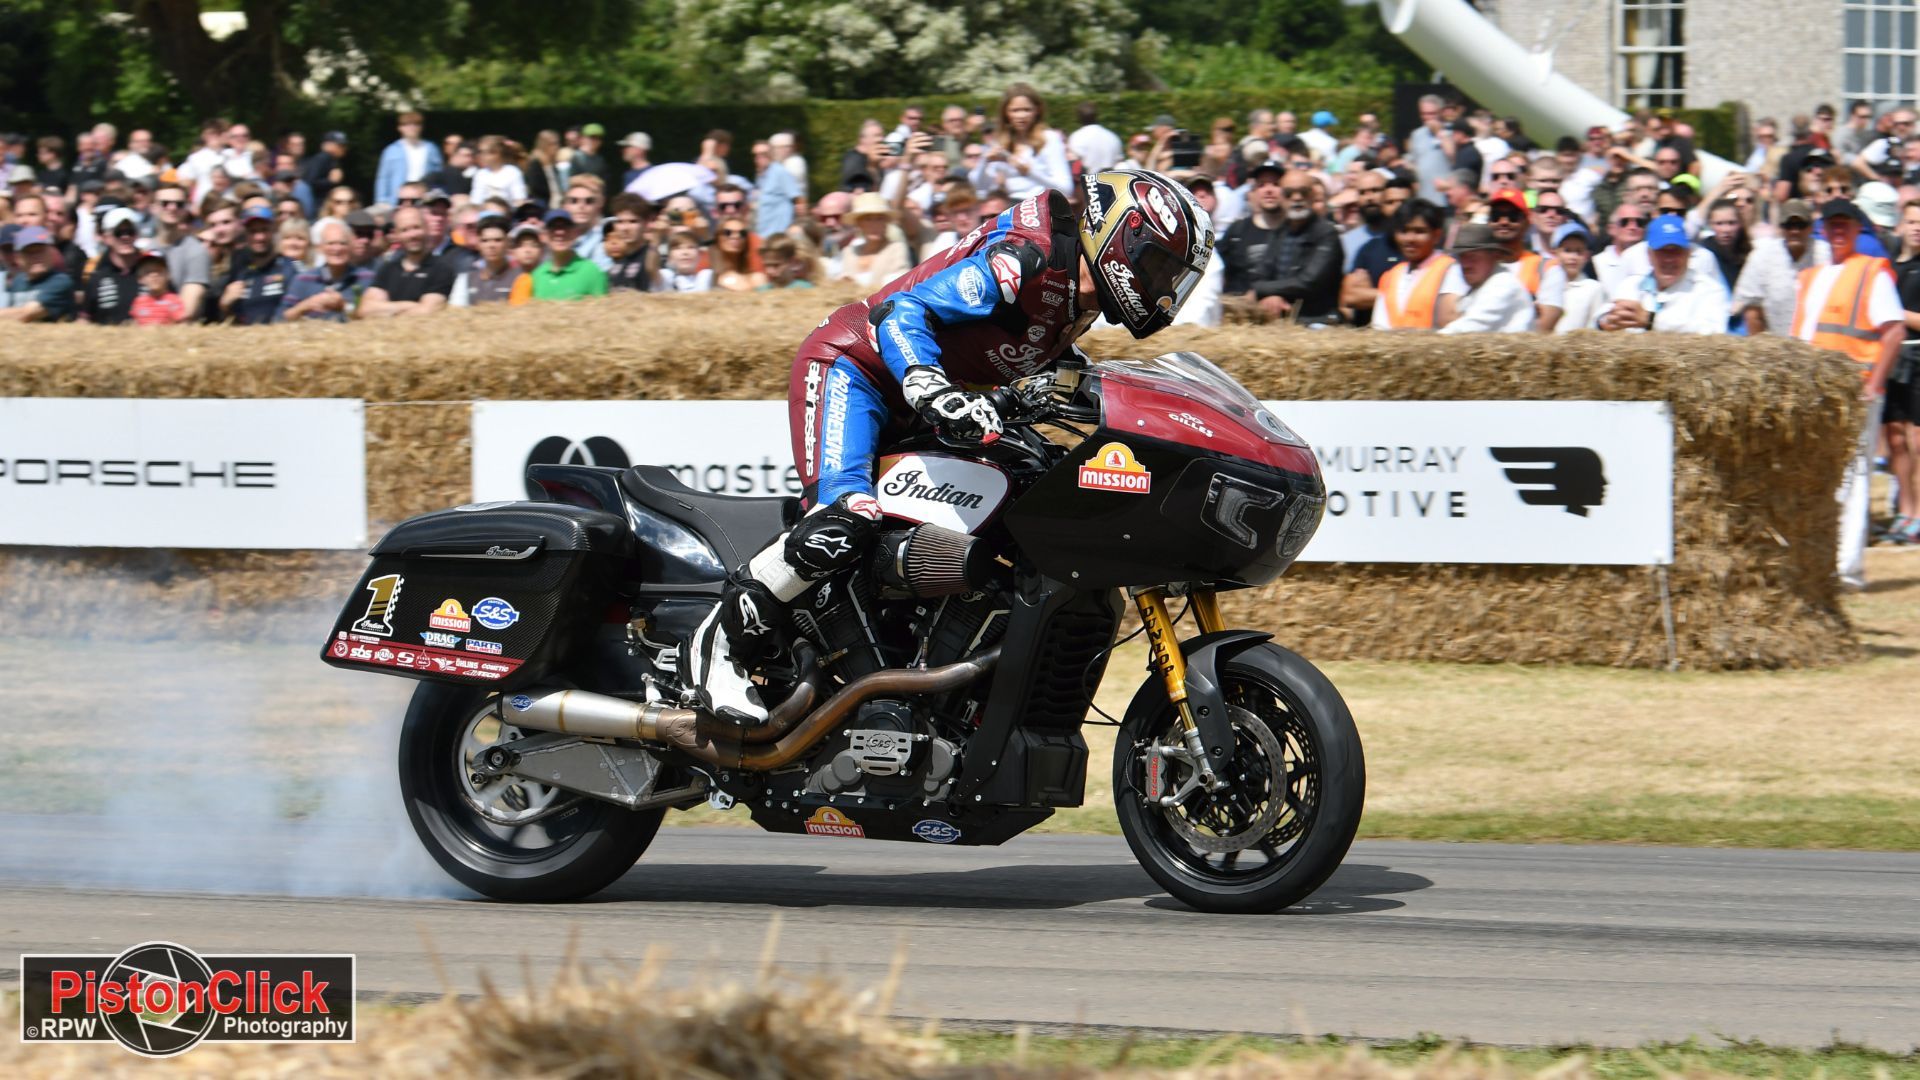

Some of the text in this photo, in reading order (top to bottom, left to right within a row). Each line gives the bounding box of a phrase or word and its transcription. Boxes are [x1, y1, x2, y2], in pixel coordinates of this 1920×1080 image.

[1085, 174, 1104, 224] SHARK
[1147, 186, 1178, 235] 99
[1103, 263, 1126, 302] MOTORCYCLE
[1110, 260, 1148, 316] Indian
[804, 361, 822, 477] alpinestars
[825, 368, 851, 470] PROGRESSIVE
[1168, 413, 1214, 438] GILLES
[0, 459, 277, 488] ORSCHE
[1316, 446, 1466, 473] MURRAY
[883, 470, 984, 509] Indian
[1328, 490, 1469, 518] OTIVE
[485, 545, 518, 557] Indian
[351, 574, 401, 636] 1
[480, 605, 513, 621] S&S
[426, 631, 455, 644] DRAG
[467, 640, 502, 650] PARTS
[1141, 604, 1175, 677] DUNLOP
[870, 739, 891, 749] S&S
[919, 825, 952, 837] S&S
